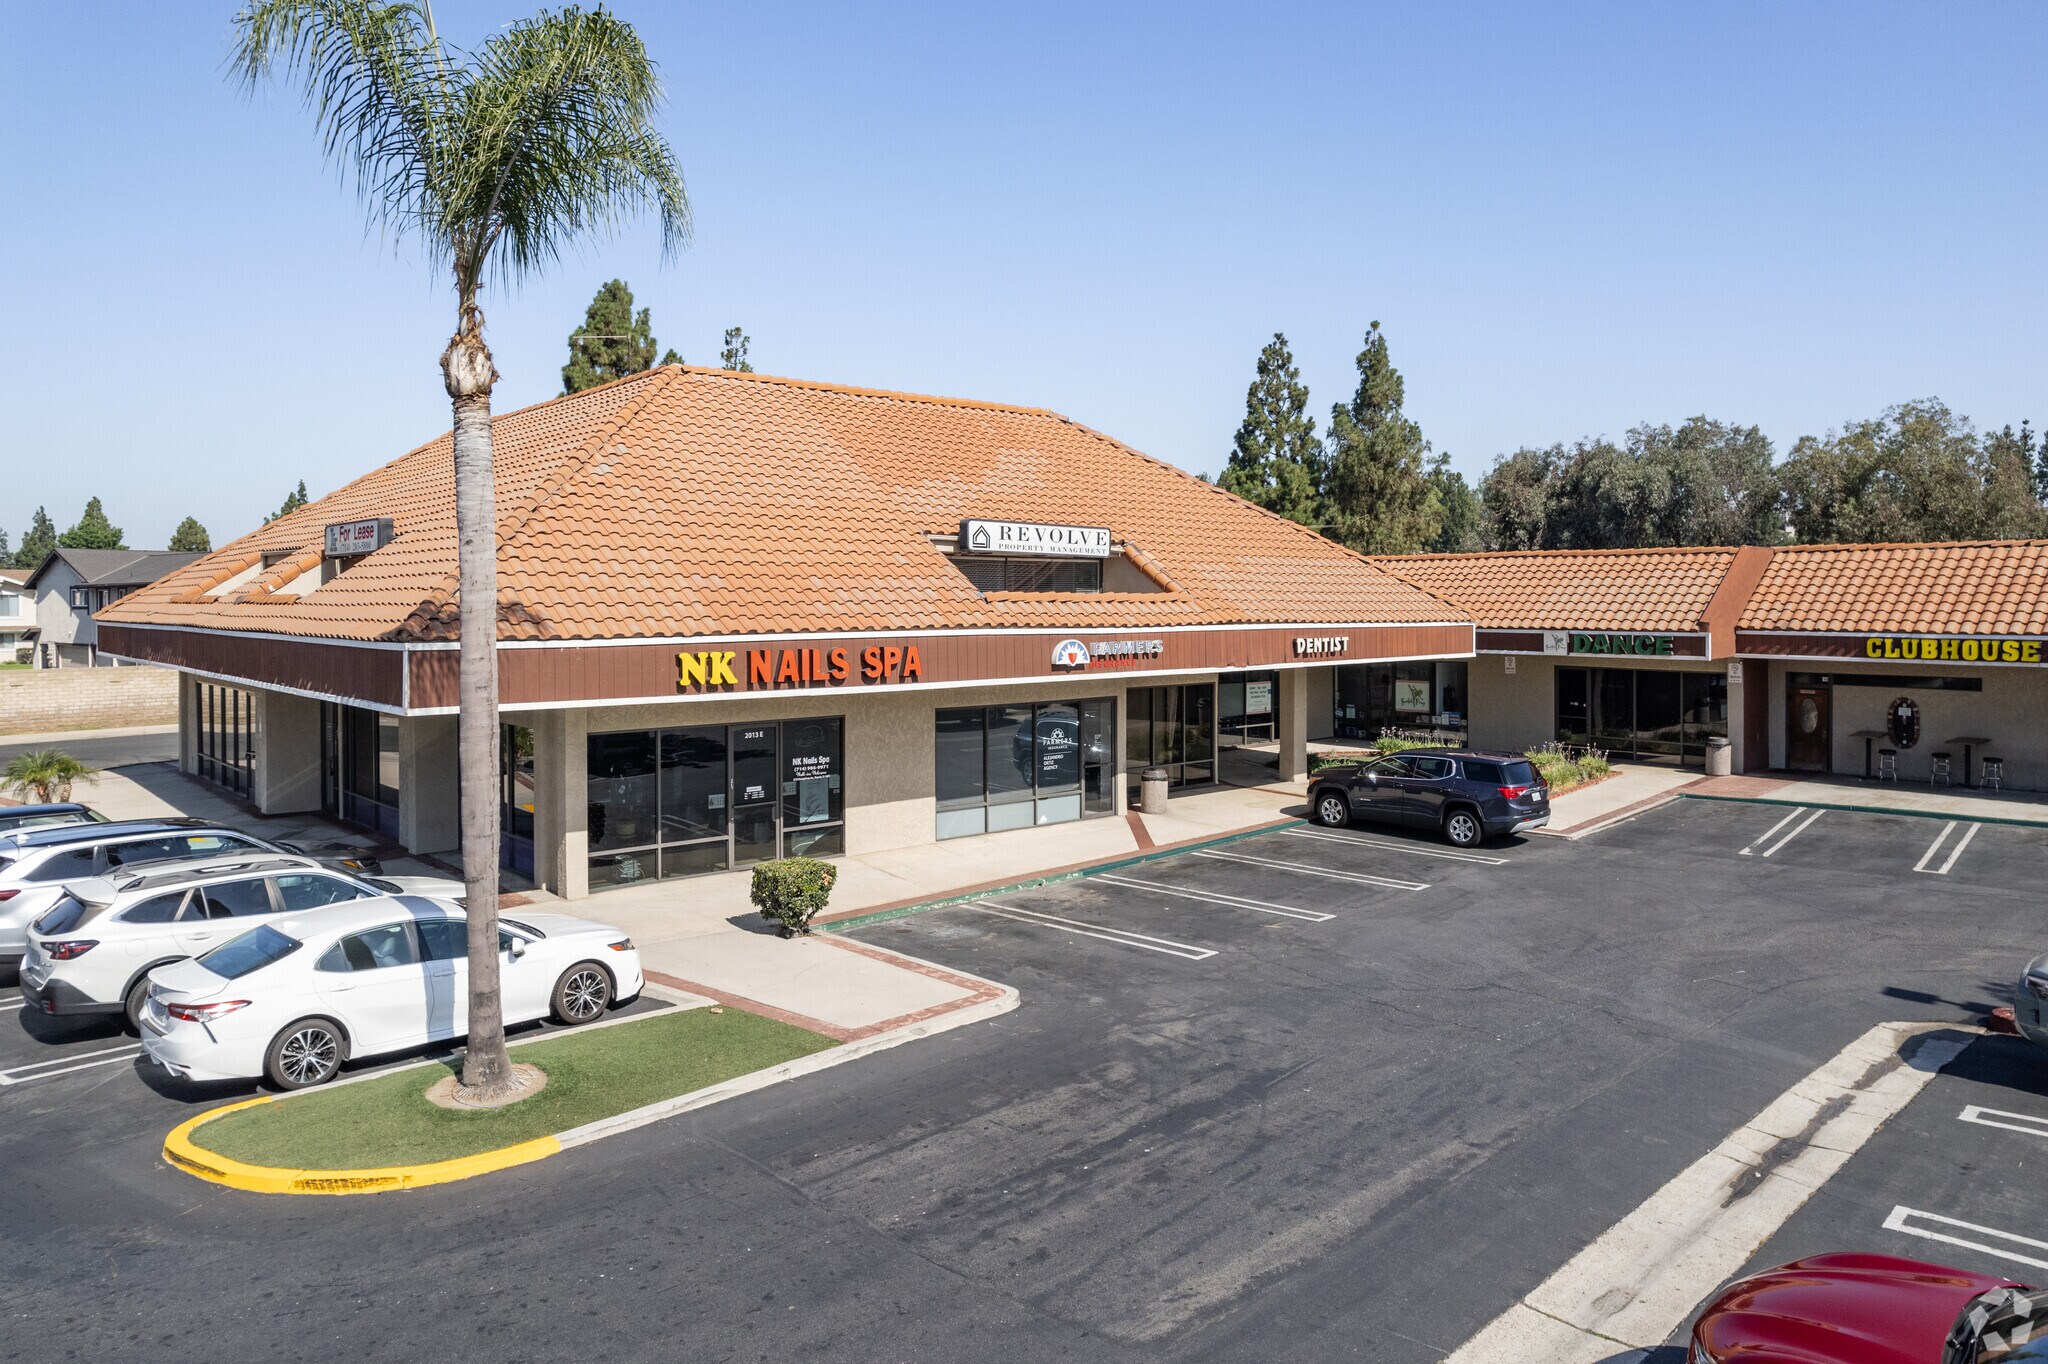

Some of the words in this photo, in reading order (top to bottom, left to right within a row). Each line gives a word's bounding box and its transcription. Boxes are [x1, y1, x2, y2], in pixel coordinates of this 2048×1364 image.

[339, 525, 351, 542] For
[354, 524, 374, 540] Lease
[999, 525, 1107, 546] REVOLVE
[998, 543, 1045, 552] PROPERTY
[1050, 546, 1107, 555] MANAGEMENT
[1091, 640, 1164, 655] FARMERS
[1296, 636, 1349, 653] DENTIST
[1573, 633, 1674, 656] DANCE
[1866, 637, 2042, 662] CLUBHOUSE
[677, 651, 739, 686] NK
[749, 647, 850, 683] NAILS
[863, 645, 923, 678] SPA
[1089, 658, 1137, 668] INSURANCE
[744, 731, 759, 739] 2013
[759, 730, 764, 738] E
[1043, 737, 1073, 746] FARMERS
[792, 757, 802, 766] NK
[803, 756, 818, 765] Nails
[818, 755, 830, 765] Spa
